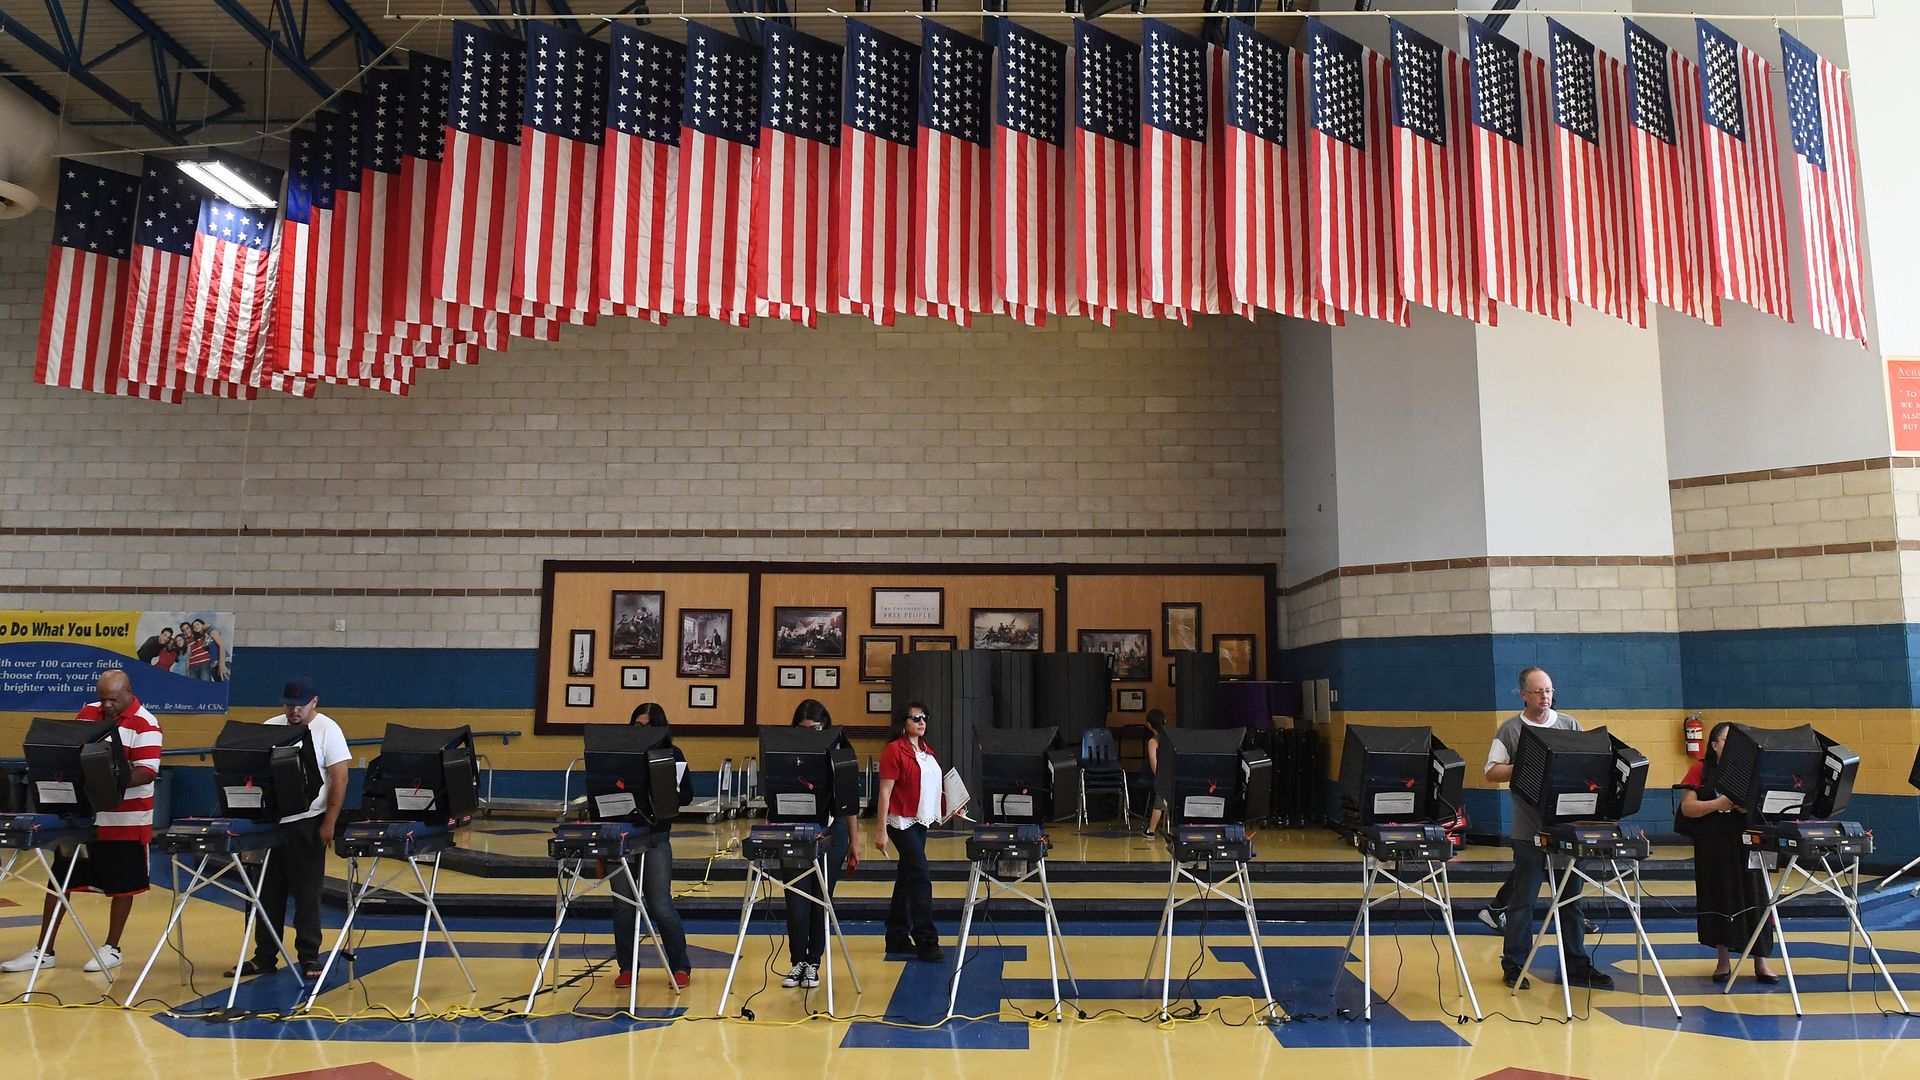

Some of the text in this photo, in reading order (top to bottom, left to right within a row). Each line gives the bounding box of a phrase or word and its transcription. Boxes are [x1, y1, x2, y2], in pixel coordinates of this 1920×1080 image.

[0, 622, 129, 637] o Do What You Love!
[14, 660, 37, 668] over
[40, 659, 59, 668] 100
[61, 660, 94, 668] career
[96, 659, 123, 669] fields
[35, 671, 63, 682] from,
[66, 673, 88, 682] your
[4, 682, 45, 694] brighter
[48, 682, 71, 693] with
[73, 684, 84, 693] us
[86, 682, 97, 693] in
[164, 703, 174, 711] Be
[175, 703, 194, 711] More.
[197, 703, 206, 711] At
[207, 703, 225, 711] CSN.
